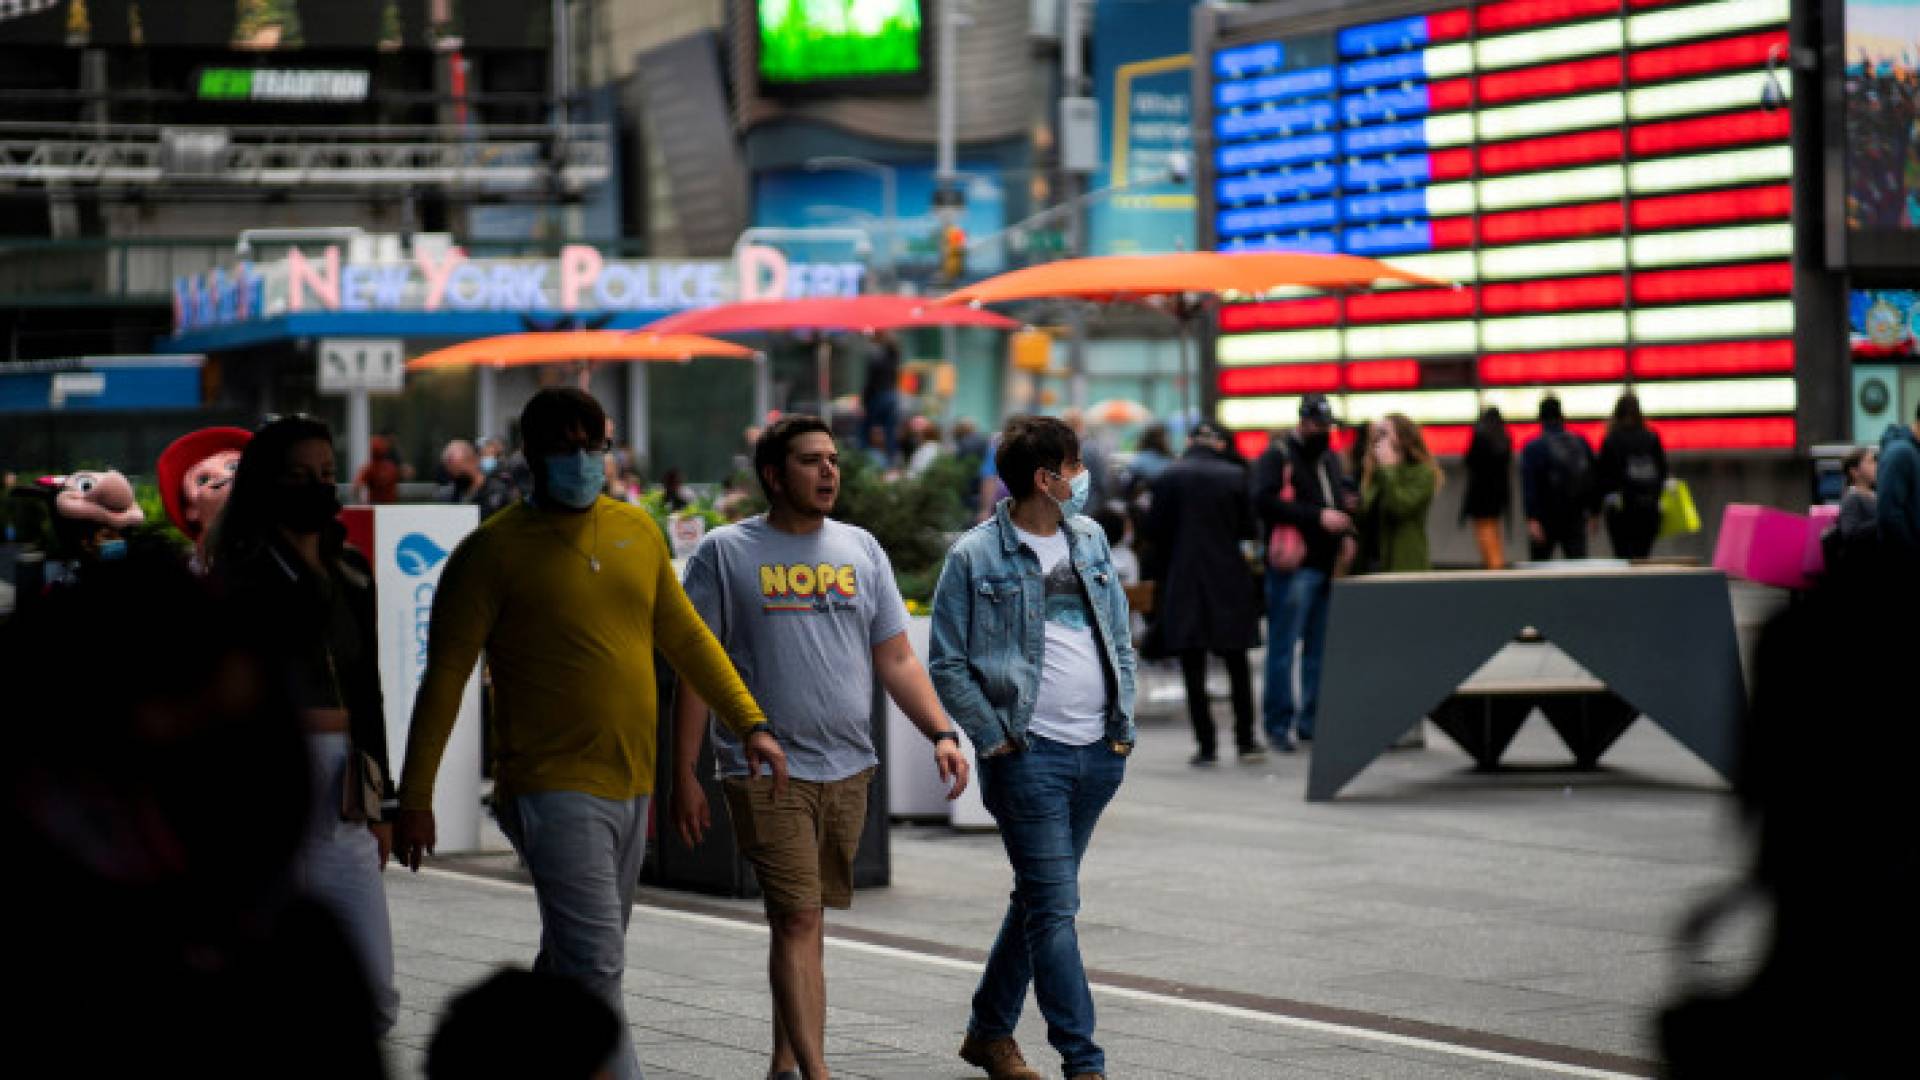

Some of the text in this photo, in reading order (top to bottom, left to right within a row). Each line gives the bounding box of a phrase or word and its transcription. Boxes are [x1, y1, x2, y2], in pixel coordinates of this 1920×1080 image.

[287, 245, 411, 311] NEW
[414, 245, 549, 312] YORK
[560, 245, 722, 311] POLICE
[759, 562, 857, 600] NOPE
